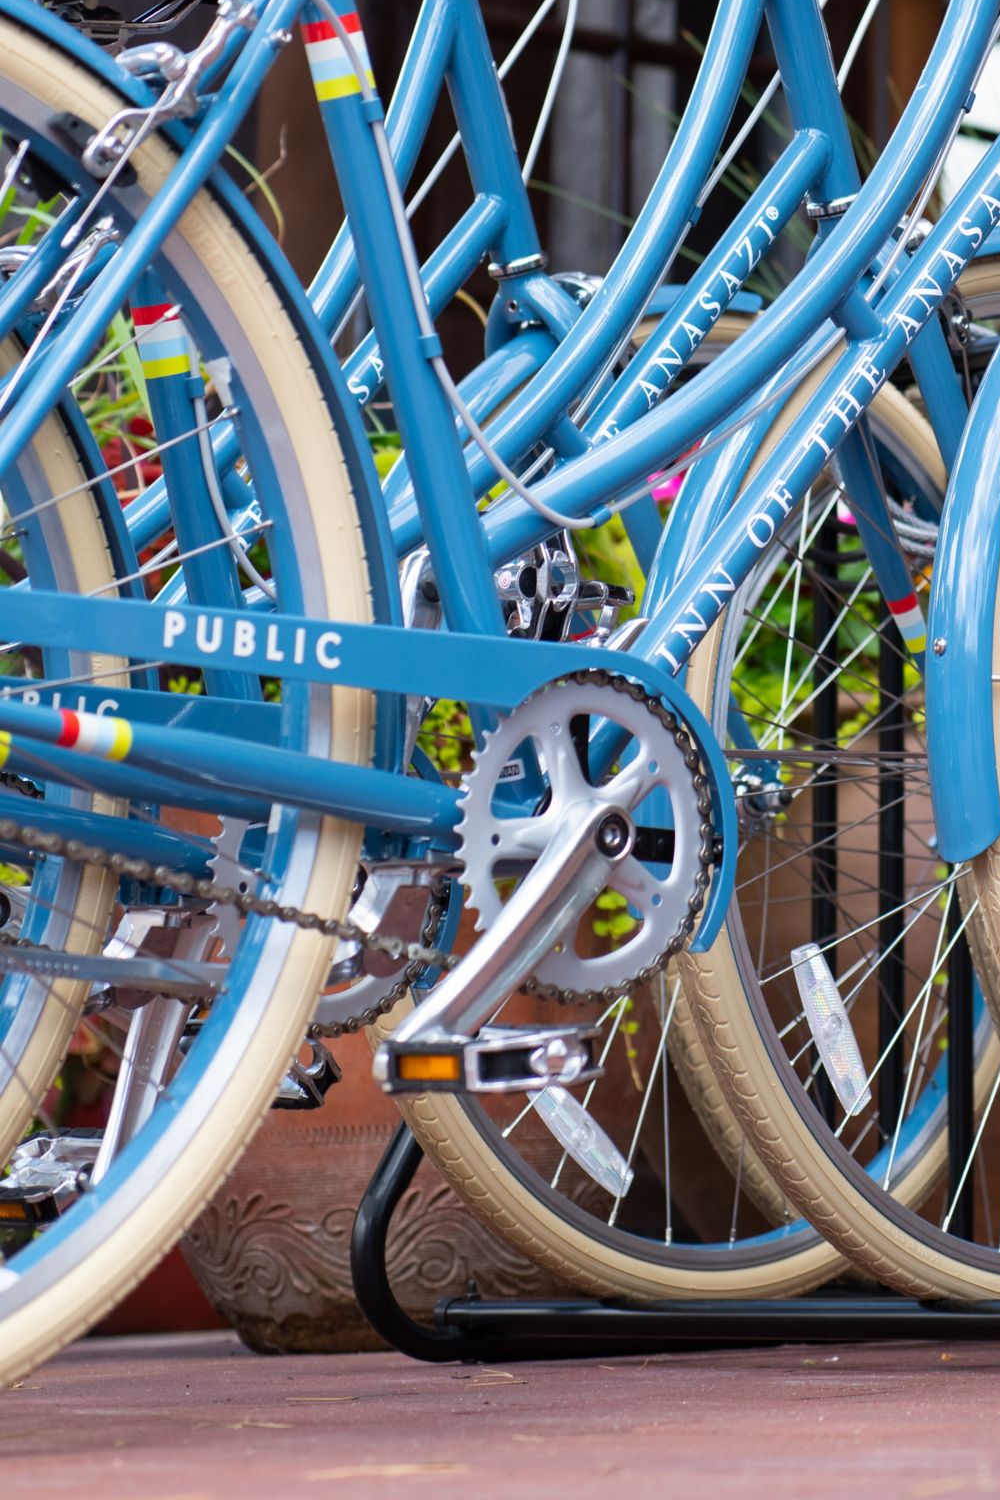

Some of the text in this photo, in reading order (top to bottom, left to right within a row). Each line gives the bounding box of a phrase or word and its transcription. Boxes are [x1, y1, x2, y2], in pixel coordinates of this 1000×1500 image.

[654, 562, 737, 677] INN
[746, 479, 794, 550] OF
[803, 355, 887, 461] THE
[163, 611, 343, 670] PUBLIC
